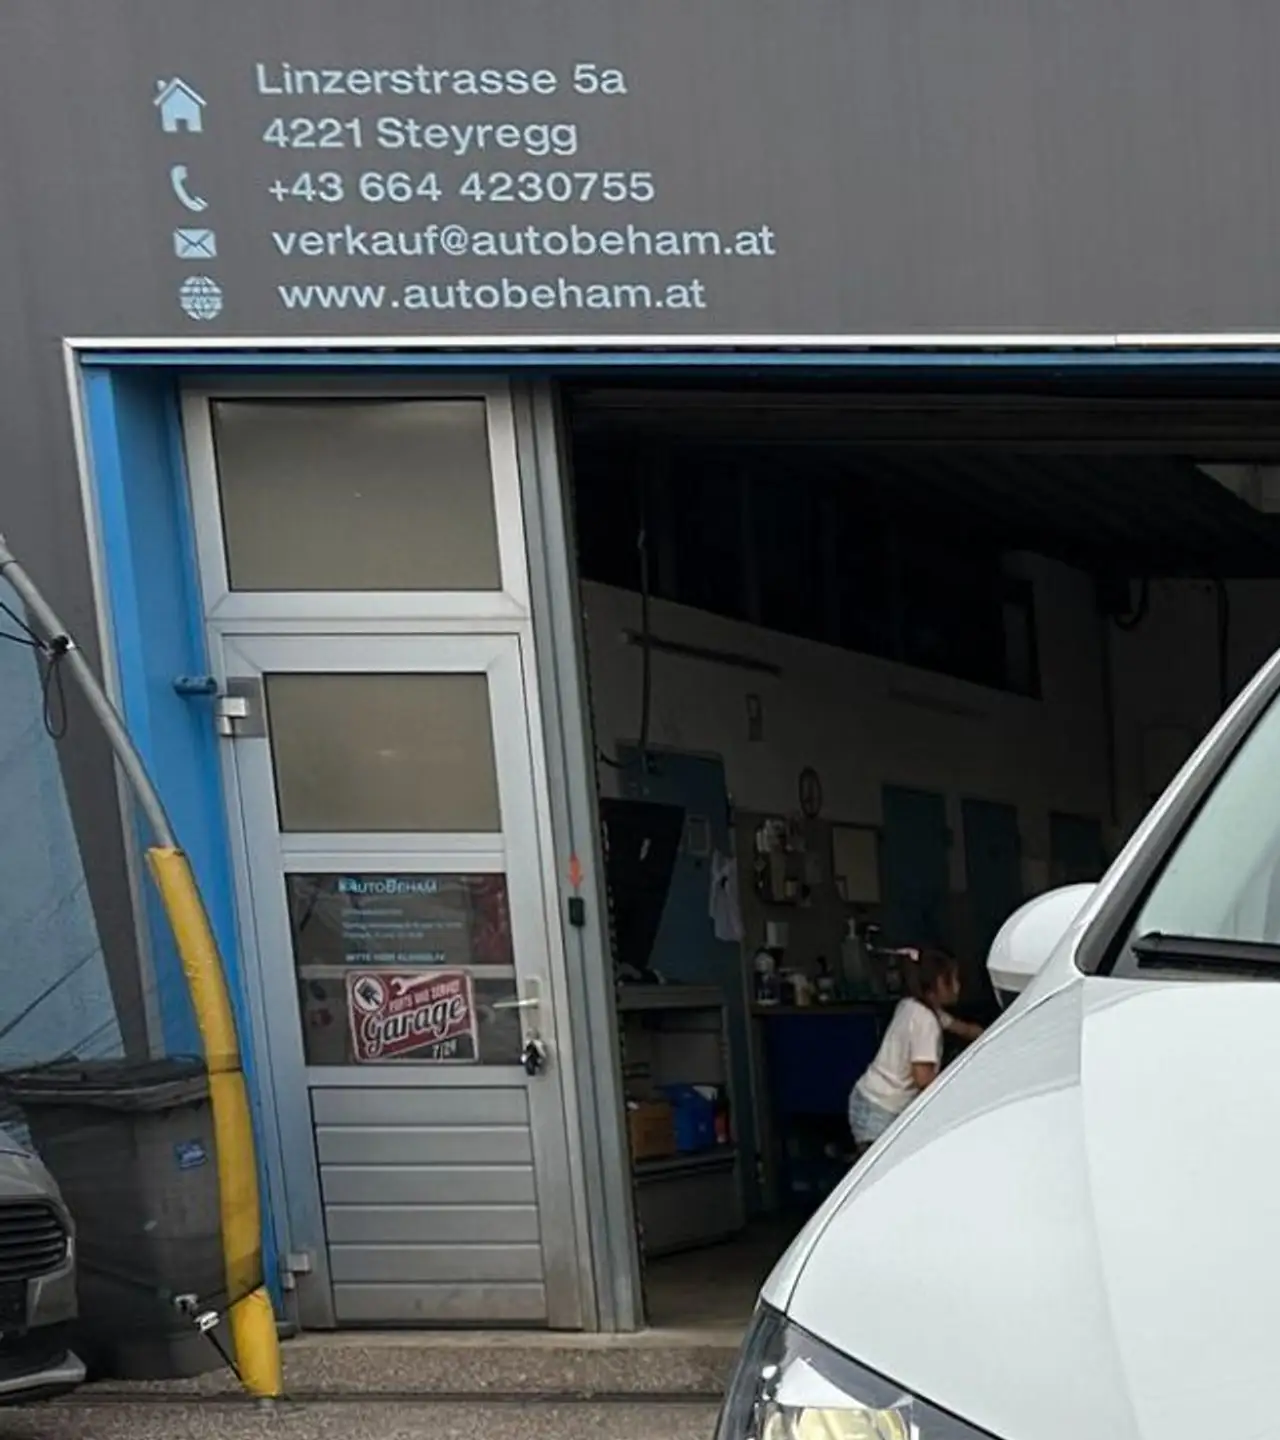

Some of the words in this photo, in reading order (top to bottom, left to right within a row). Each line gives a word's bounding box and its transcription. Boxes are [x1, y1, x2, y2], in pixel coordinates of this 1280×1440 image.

[256, 62, 558, 95] Linzerstrasse
[573, 63, 628, 94] 5a
[262, 117, 362, 148] 4221
[377, 117, 578, 156] Steyregg
[268, 171, 344, 203] +43
[359, 171, 443, 202] 664
[459, 171, 655, 202] 4230755
[272, 223, 776, 256] verkauf@autobeham.at
[277, 277, 707, 309] www.autobeham.at
[361, 993, 468, 1058] Garage
